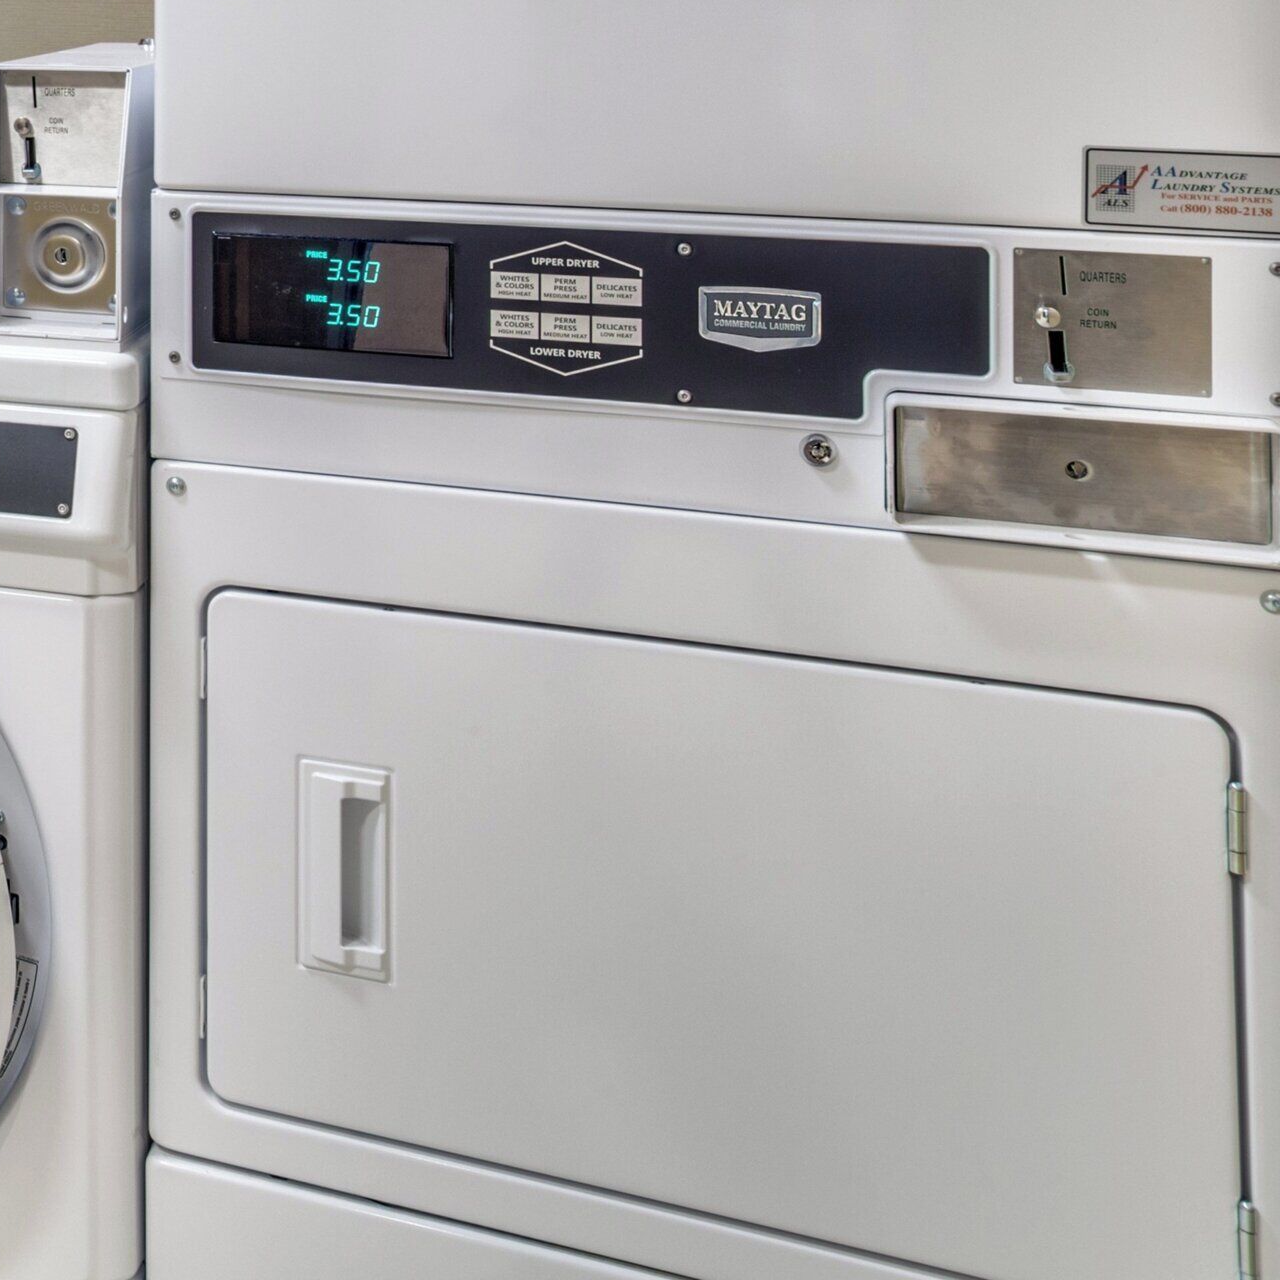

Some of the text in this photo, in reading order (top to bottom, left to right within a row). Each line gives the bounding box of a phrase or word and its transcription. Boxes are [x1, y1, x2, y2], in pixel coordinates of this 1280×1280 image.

[44, 88, 75, 97] QUARTERS
[44, 126, 68, 134] RETURN
[1151, 179, 1280, 196] LAUNDRY SYSTEMS
[1103, 198, 1130, 208] ALS
[1161, 192, 1175, 200] For
[1177, 193, 1221, 202] SERVICE
[1241, 196, 1273, 204] PARTS
[1180, 204, 1212, 215] (800)
[1215, 205, 1273, 218] 880-2138
[306, 250, 328, 259] PRICE
[532, 256, 600, 268] UPPER DRYER
[326, 259, 381, 284] 3.50
[1080, 270, 1127, 284] QUARTERS
[504, 282, 534, 290] COLORS
[596, 284, 638, 292] DELICATES
[306, 294, 328, 303] PRICE
[326, 303, 381, 328] 3.50
[714, 300, 806, 321] MAYTAG
[1088, 308, 1109, 317] COIN
[500, 314, 530, 322] WHITES
[554, 324, 577, 332] PRESS
[596, 323, 638, 331] DELICATES
[714, 318, 806, 332] COMMERCIAL LAUNDRY
[1080, 319, 1117, 330] RETURN
[530, 347, 602, 360] LOWER DRYER
